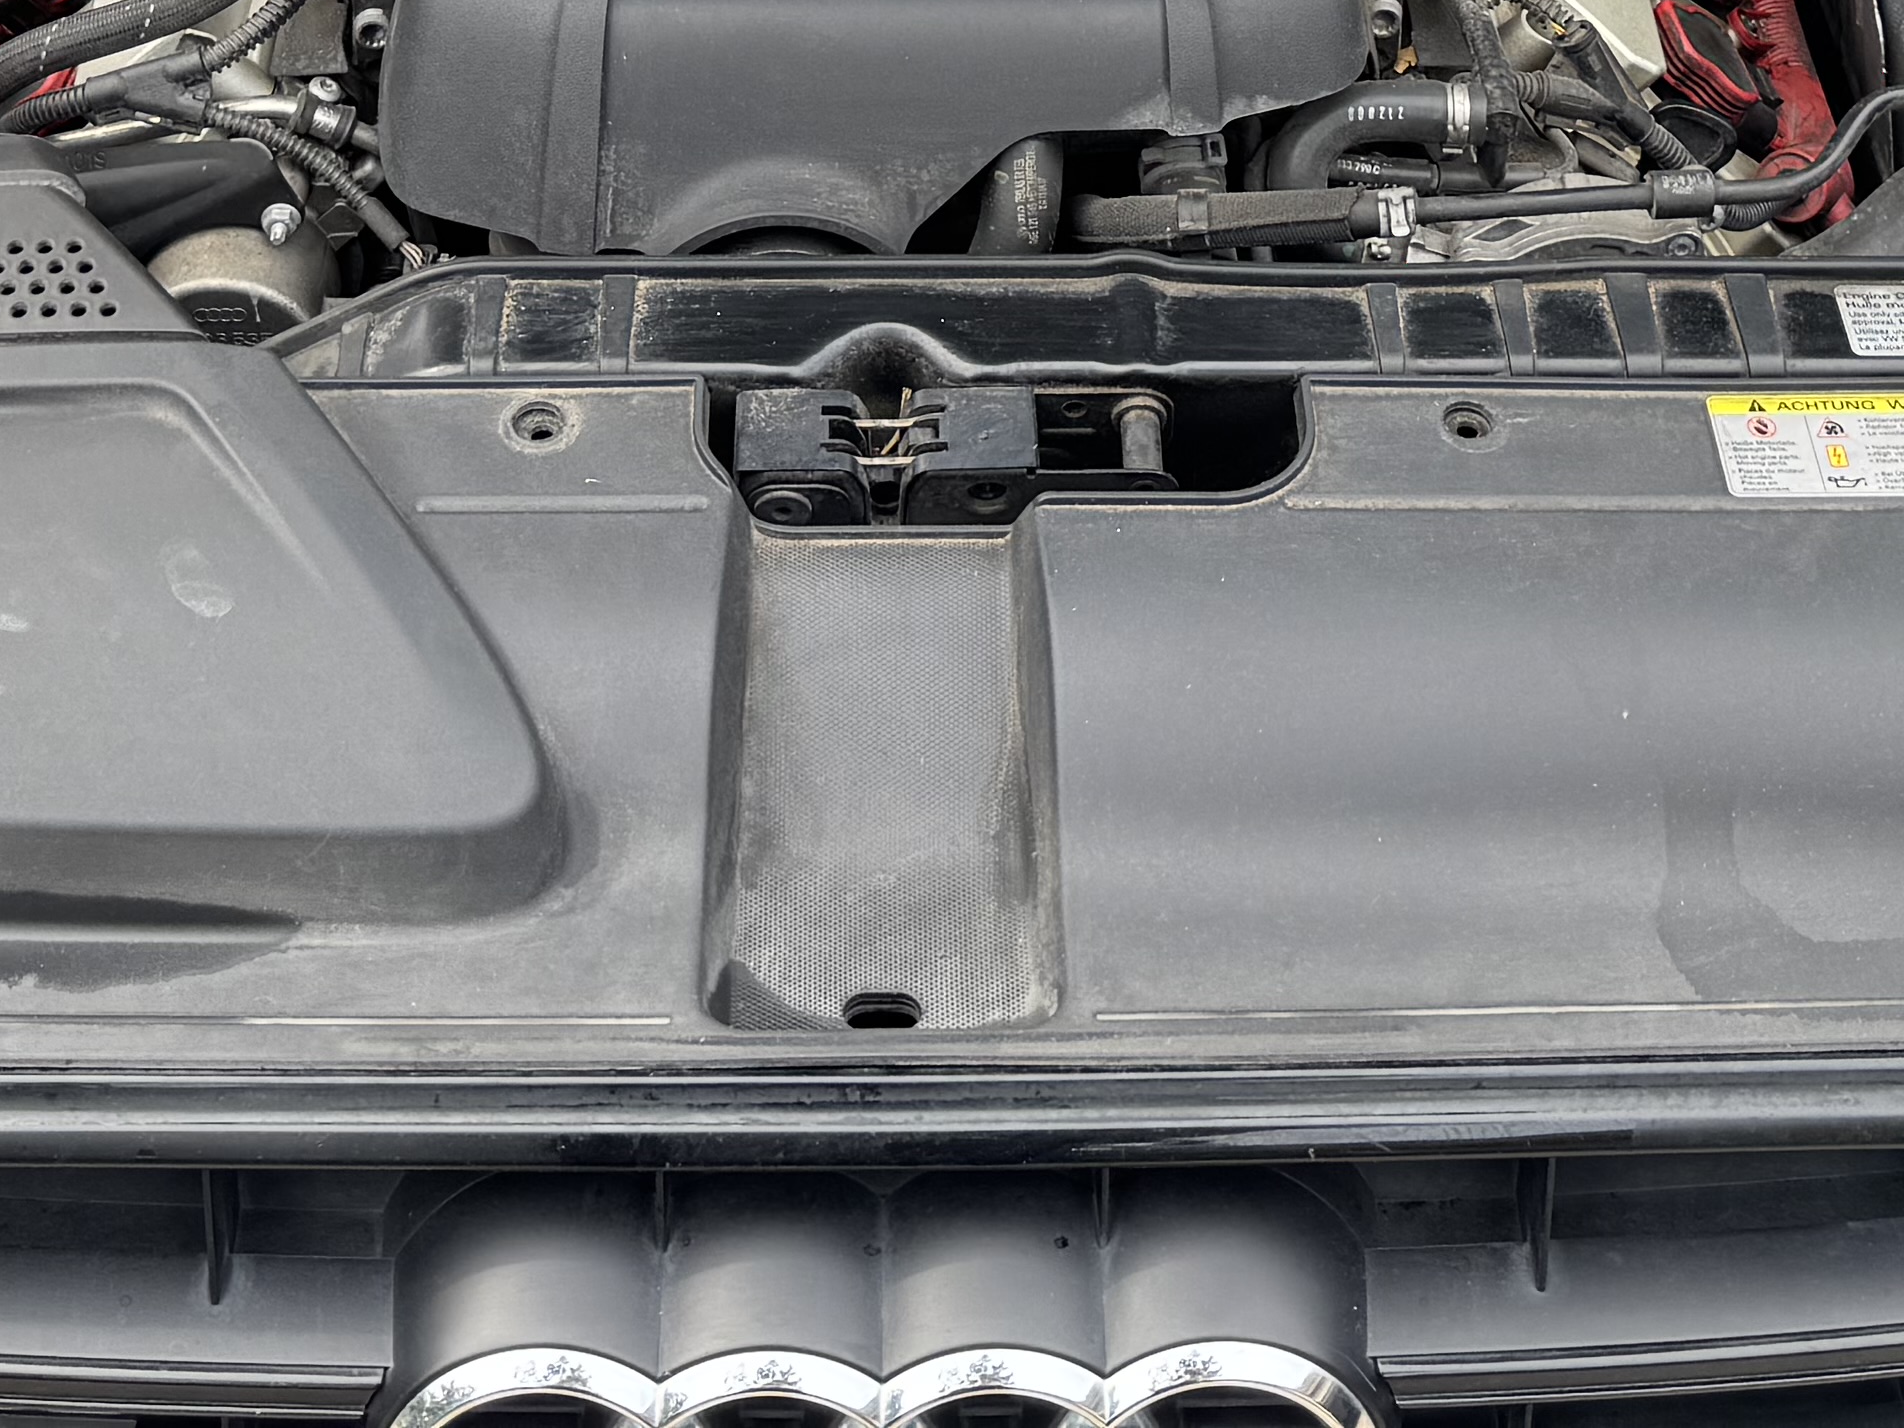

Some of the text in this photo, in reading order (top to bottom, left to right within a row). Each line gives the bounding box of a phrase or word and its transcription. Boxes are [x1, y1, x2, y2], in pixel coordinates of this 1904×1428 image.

[1842, 292, 1891, 301] Engine
[1845, 301, 1881, 309] Huile
[1870, 311, 1891, 319] only
[1777, 400, 1876, 411] ACHTUNG
